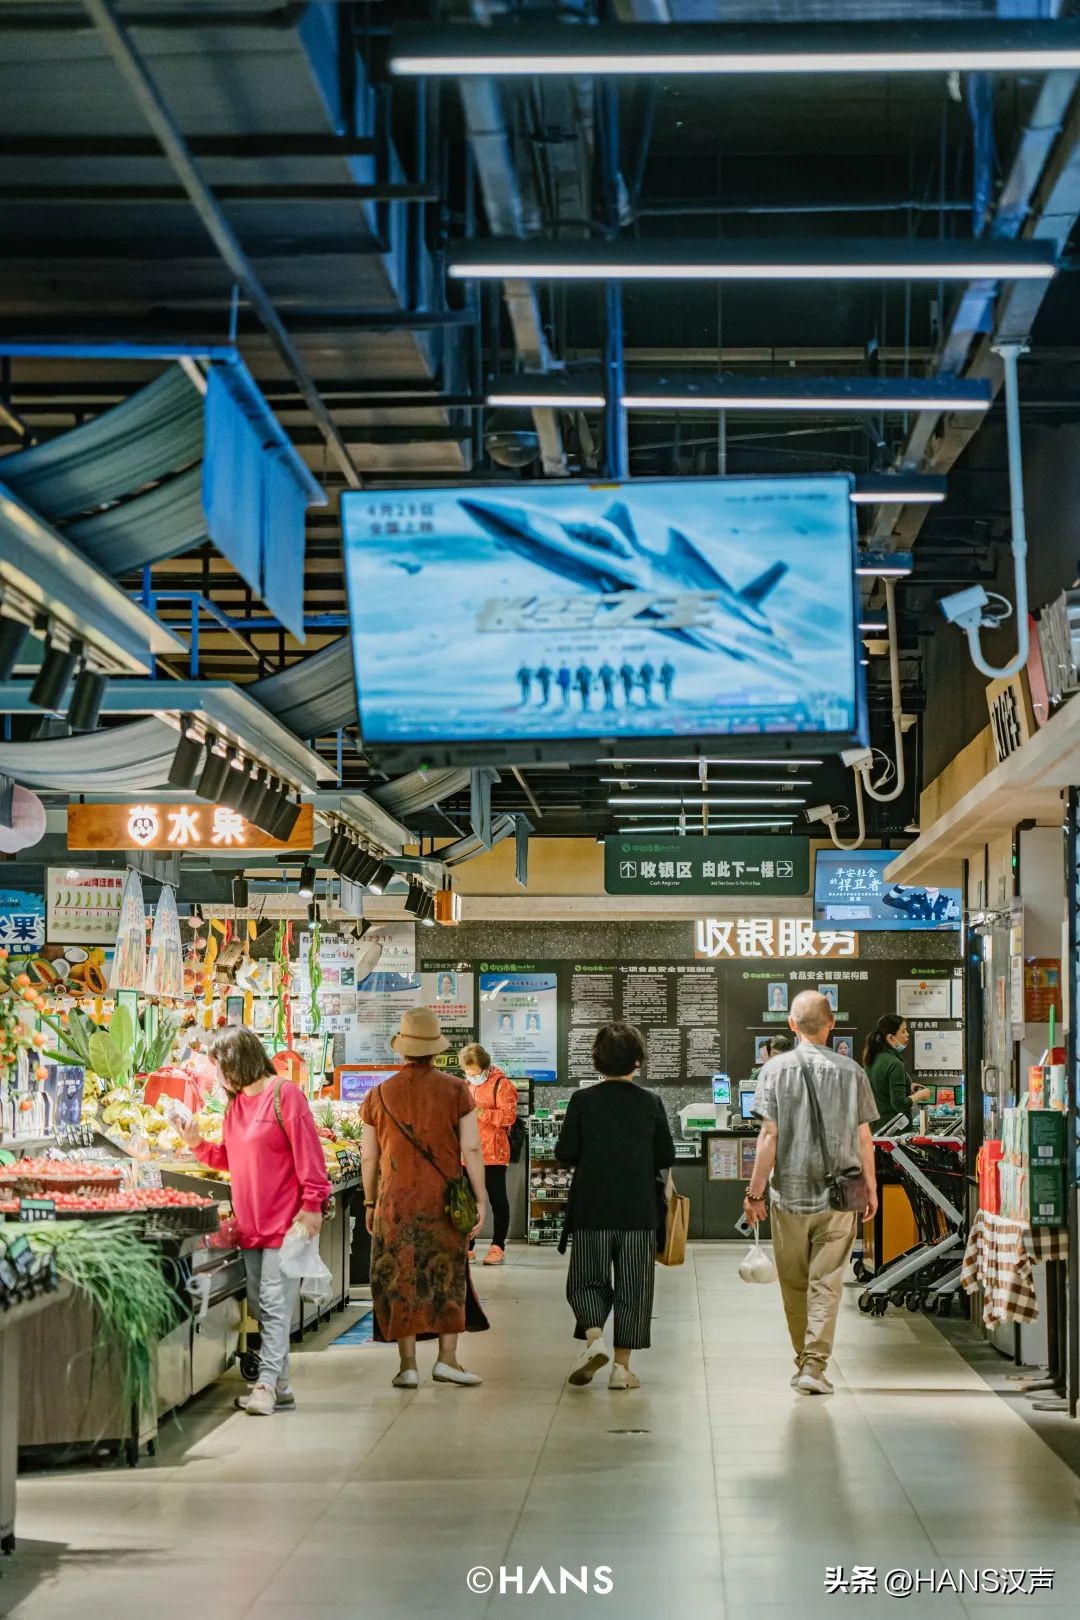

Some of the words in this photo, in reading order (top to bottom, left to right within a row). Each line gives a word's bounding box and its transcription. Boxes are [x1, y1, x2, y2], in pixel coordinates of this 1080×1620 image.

[168, 807, 245, 844] 水果
[641, 861, 693, 879] 收银区
[702, 861, 774, 879] 由此下一楼
[0, 915, 38, 941] 果
[696, 918, 856, 957] 收银服务
